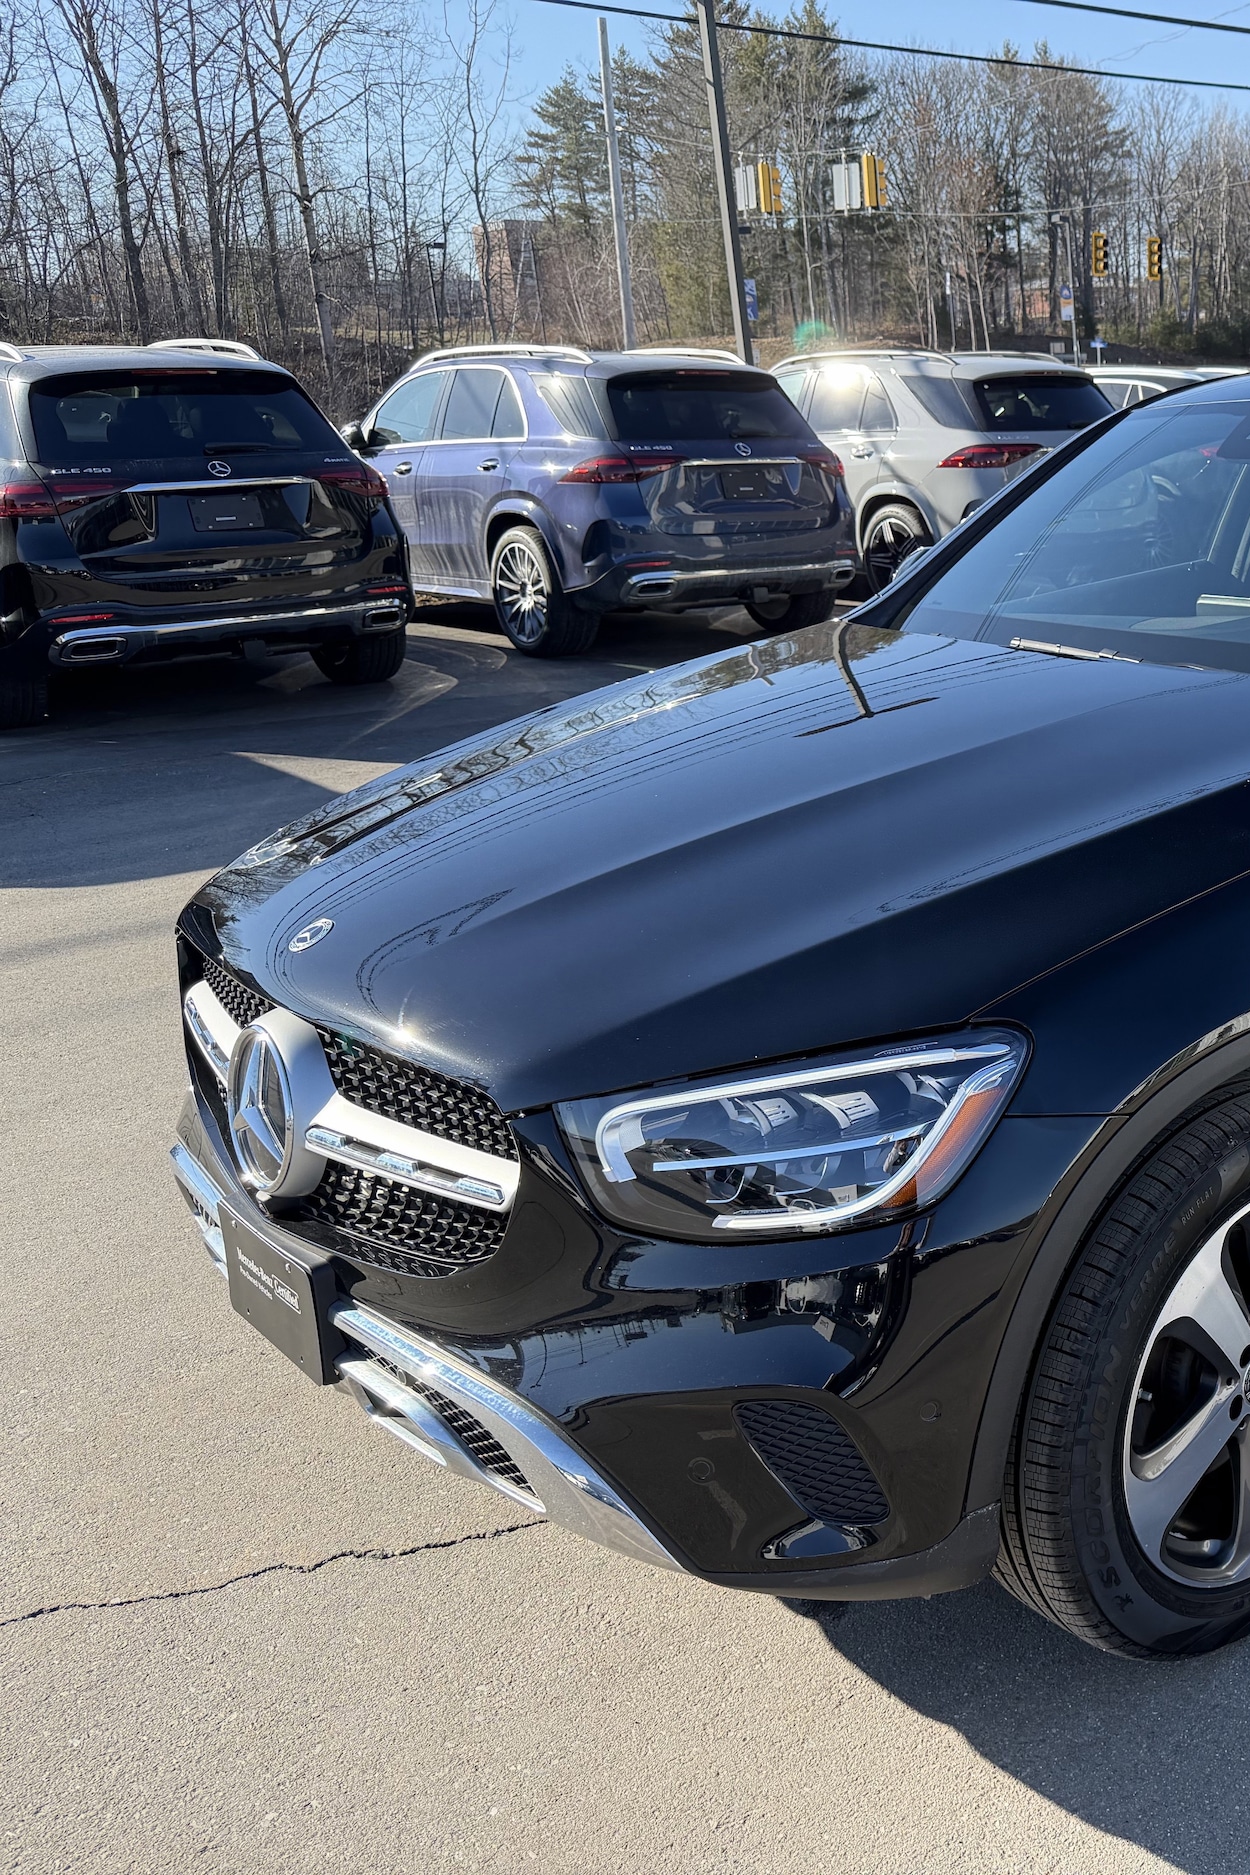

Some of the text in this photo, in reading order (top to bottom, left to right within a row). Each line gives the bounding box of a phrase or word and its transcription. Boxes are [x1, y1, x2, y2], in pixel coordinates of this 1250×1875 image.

[1181, 1186, 1214, 1226] RUN FLAT
[237, 1246, 299, 1310] Mercedes-Benz Certified
[1084, 1343, 1123, 1589] SCORPION
[1119, 1231, 1178, 1330] VERDE
